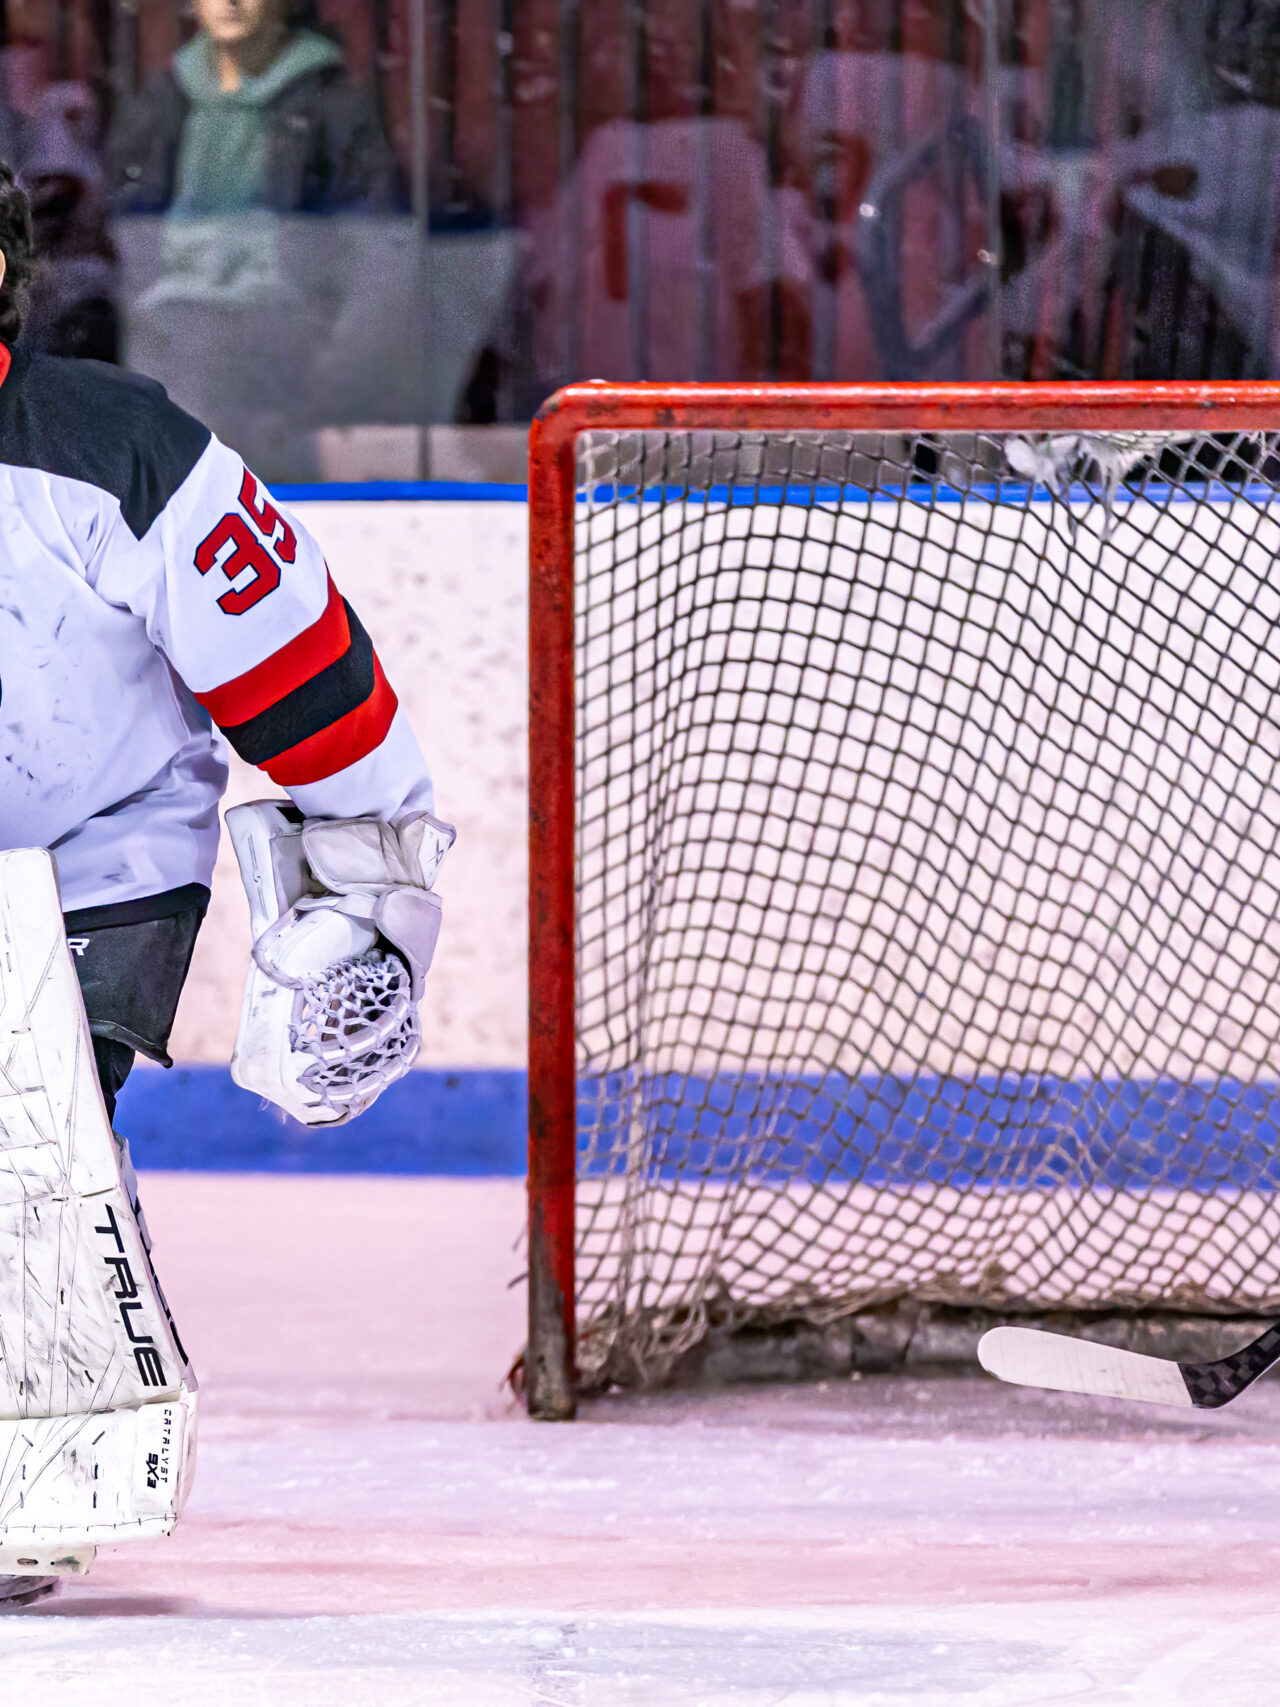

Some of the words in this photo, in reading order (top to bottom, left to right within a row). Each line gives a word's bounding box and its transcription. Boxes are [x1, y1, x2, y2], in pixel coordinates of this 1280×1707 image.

[193, 465, 297, 616] 35
[94, 1203, 168, 1387] TRUE
[160, 1408, 172, 1484] CATALYST
